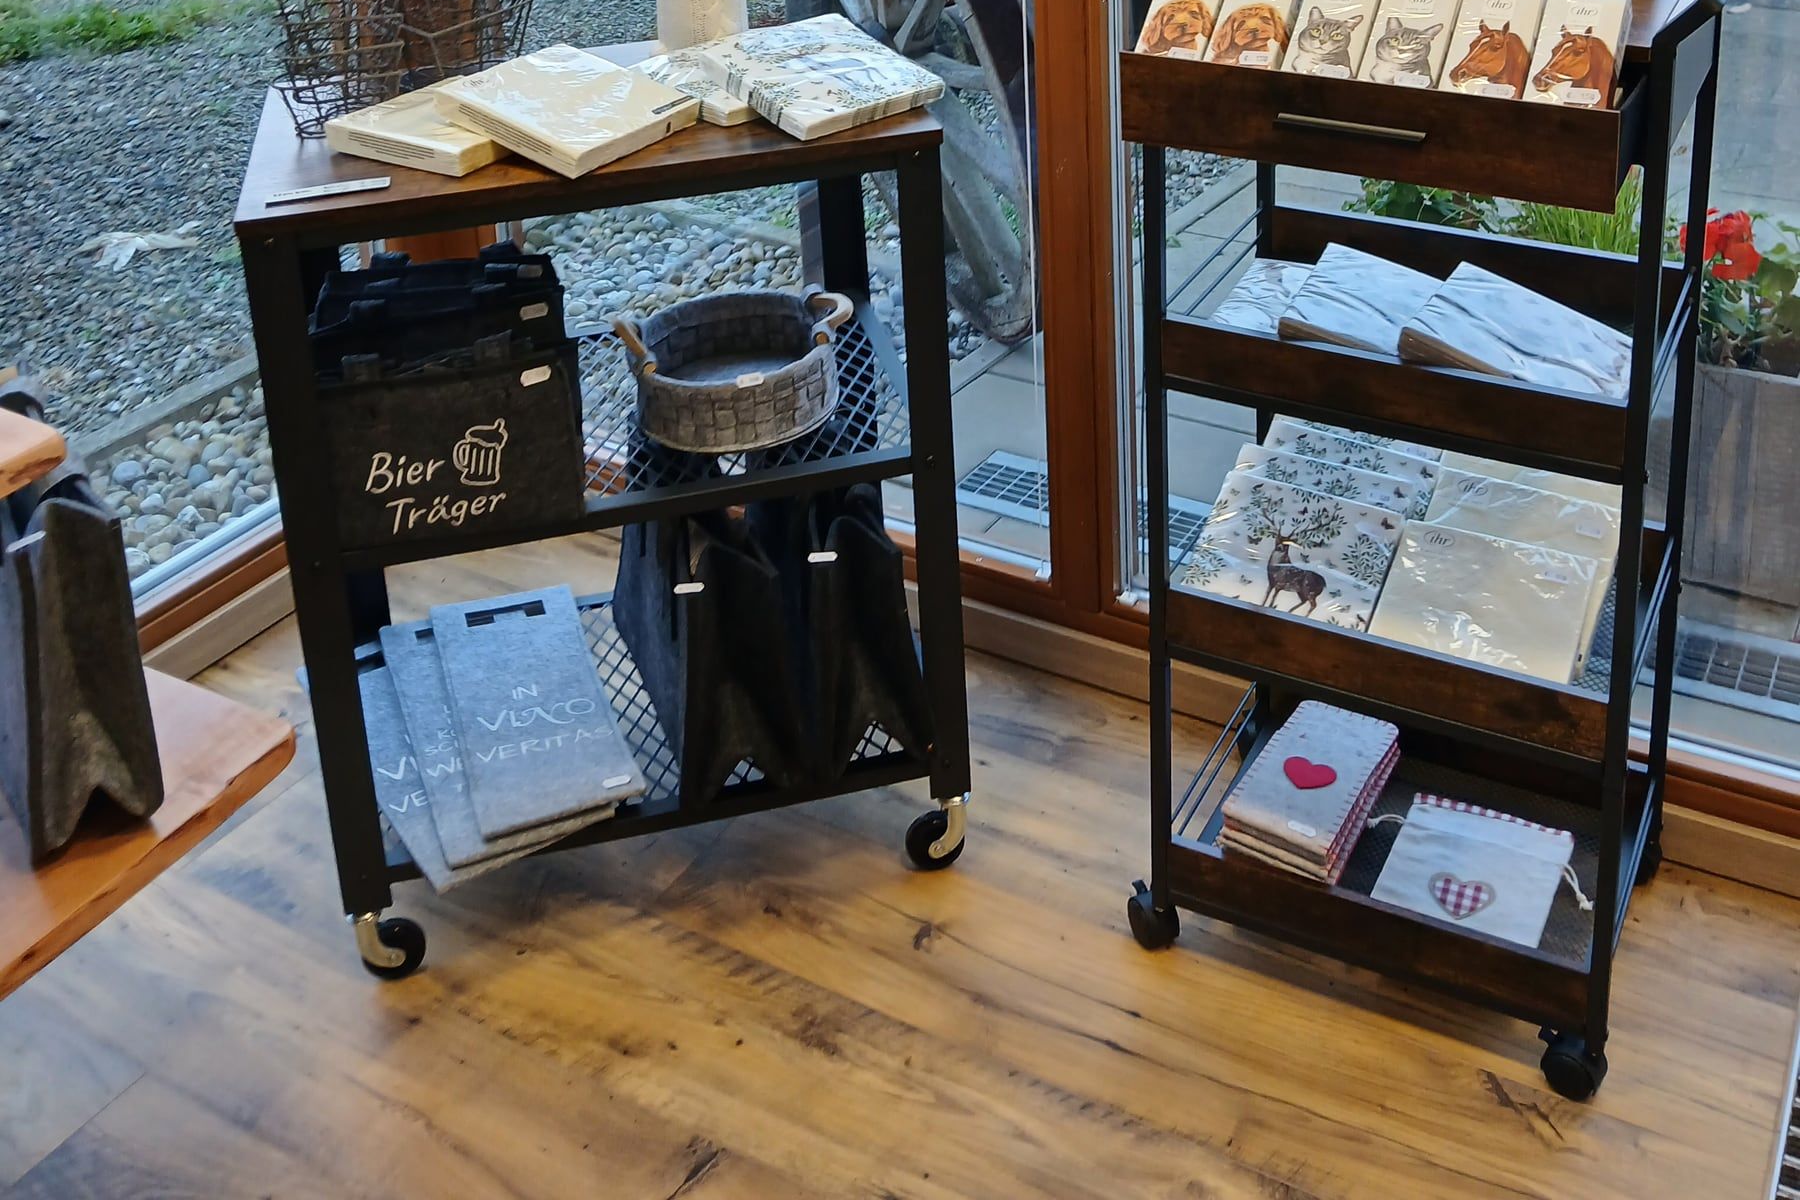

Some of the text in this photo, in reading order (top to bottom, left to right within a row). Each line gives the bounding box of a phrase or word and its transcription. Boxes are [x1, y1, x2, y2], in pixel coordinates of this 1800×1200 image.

[1575, 5, 1594, 17] ihr
[365, 451, 446, 495] Bier
[385, 492, 507, 535] Träger
[1429, 532, 1452, 545] ihr
[511, 684, 538, 700] IN
[476, 727, 615, 763] VERITAS
